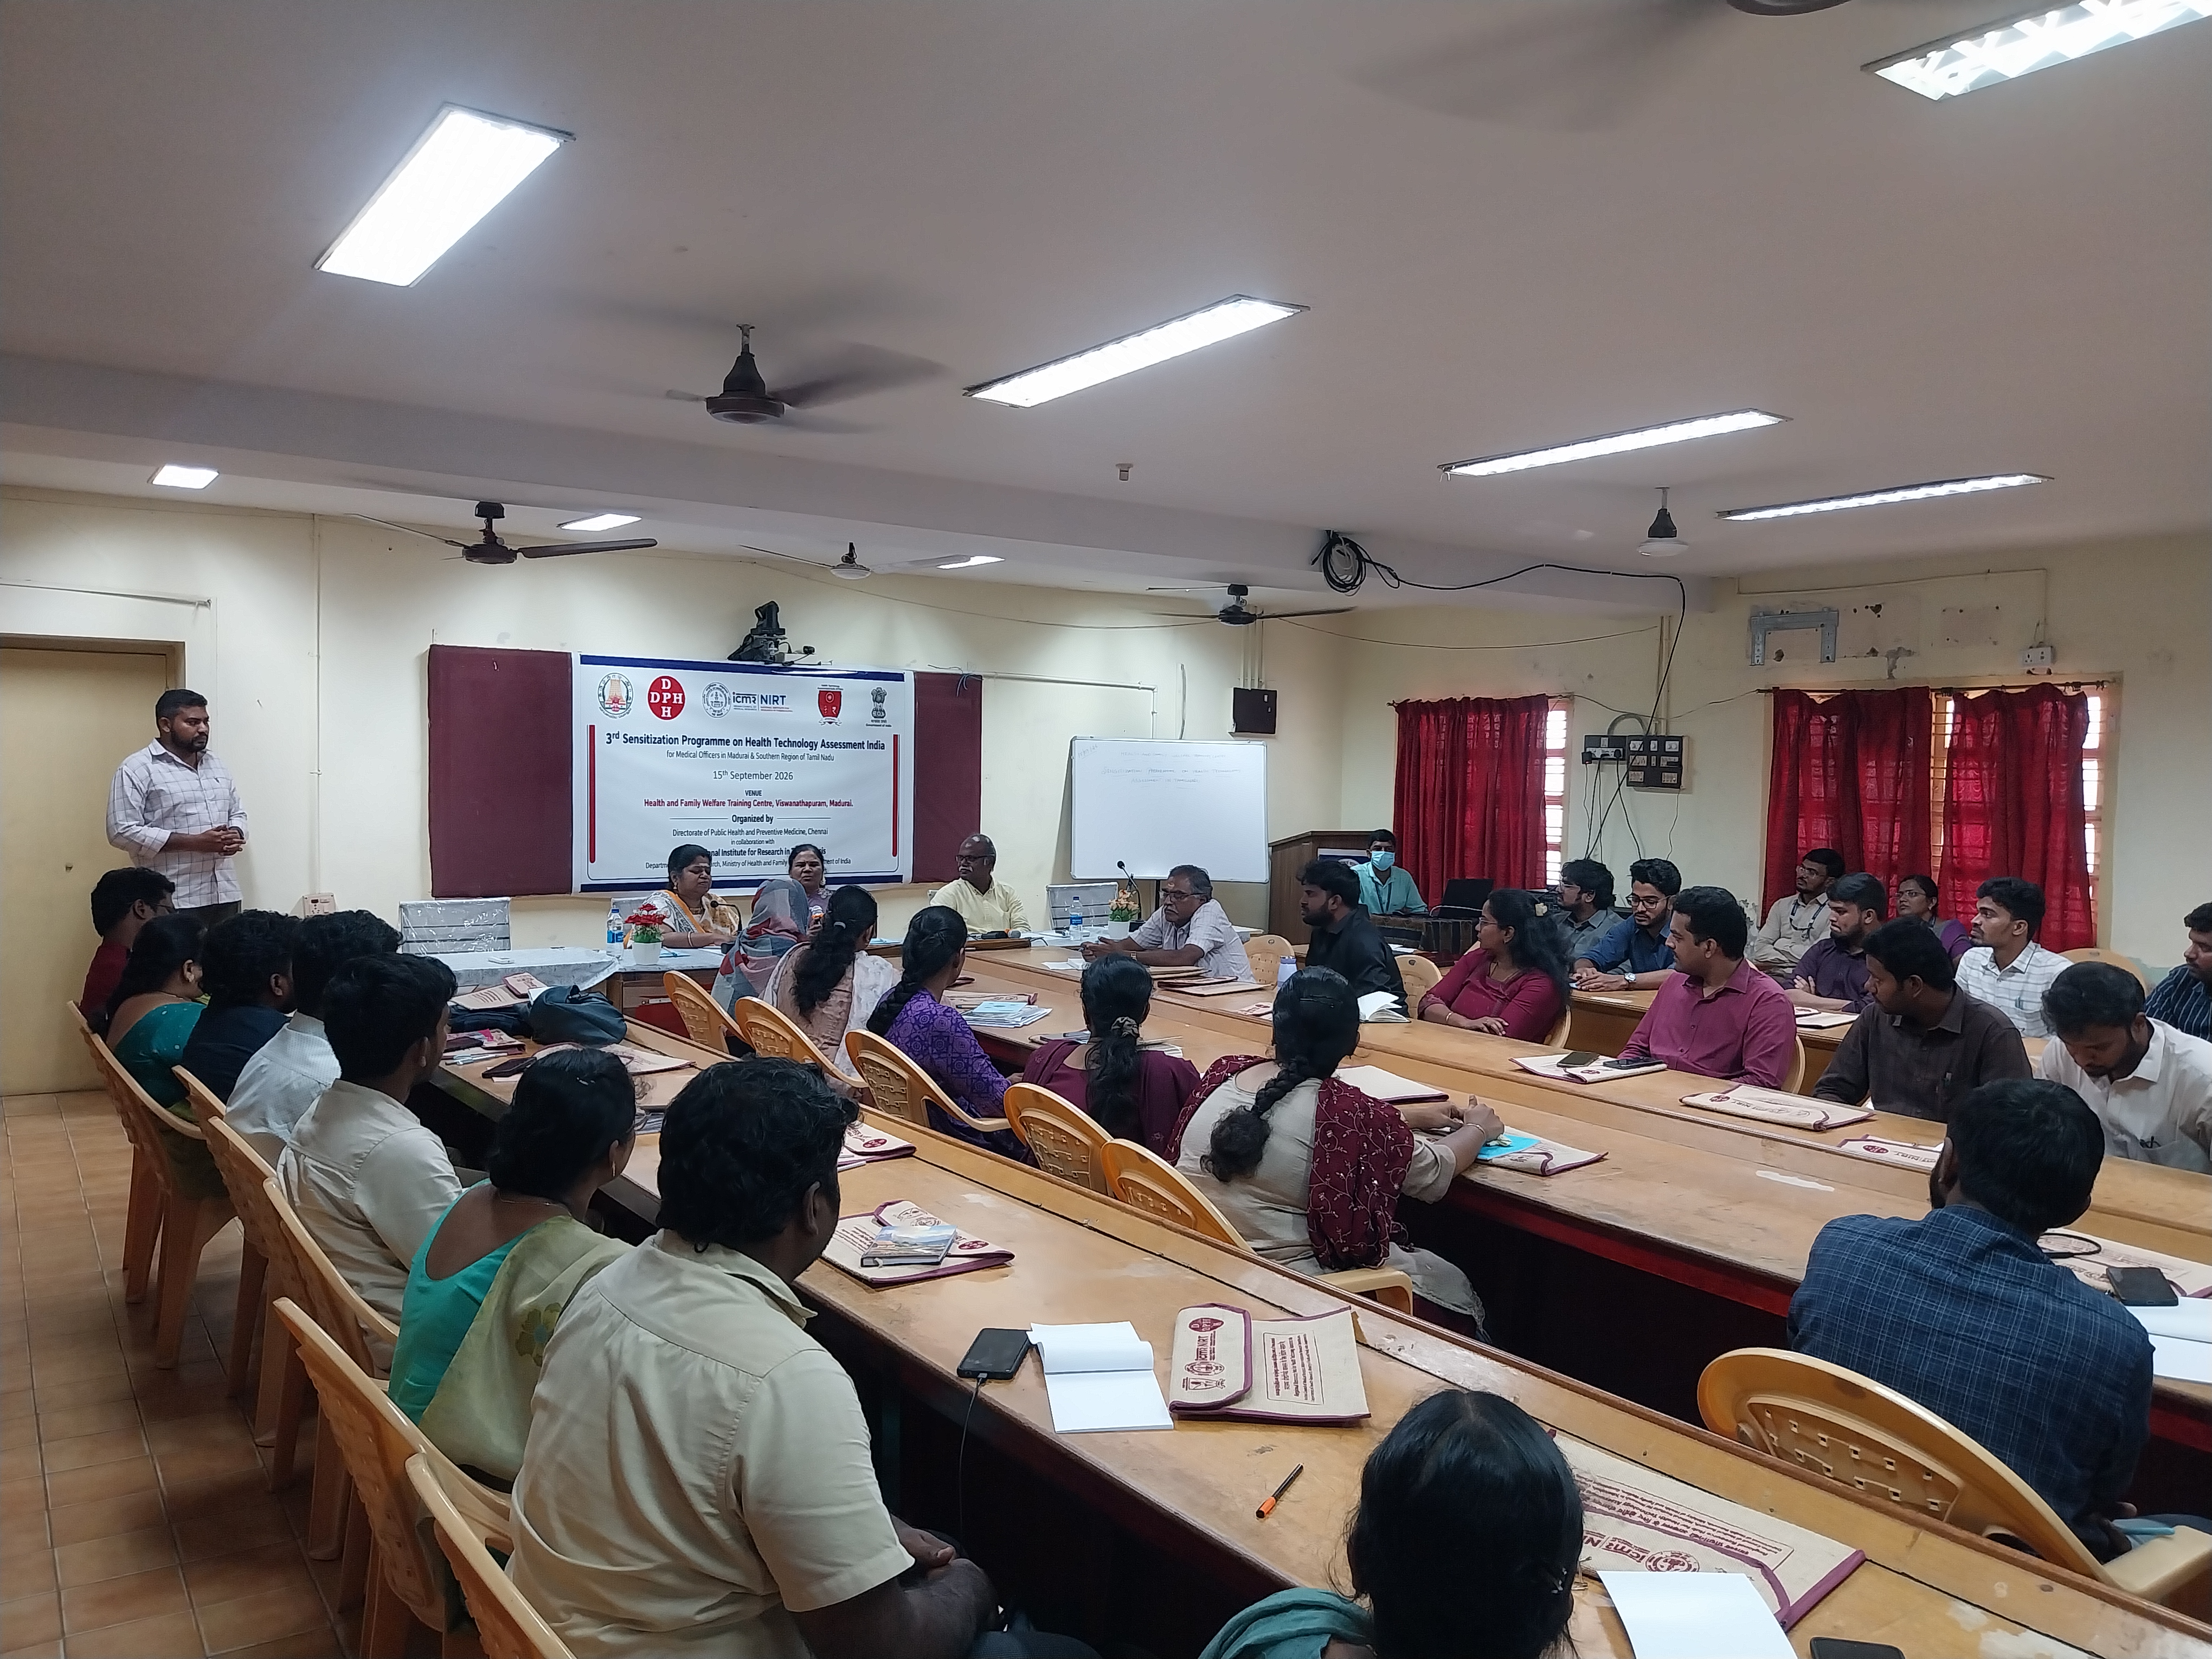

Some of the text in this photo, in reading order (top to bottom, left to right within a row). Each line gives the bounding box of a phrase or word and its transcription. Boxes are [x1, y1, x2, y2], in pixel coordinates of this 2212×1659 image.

[661, 678, 671, 689] D
[650, 692, 683, 704] DPH
[761, 695, 786, 705] NIRT
[661, 706, 671, 717] H
[606, 731, 619, 744] 3rd
[623, 734, 679, 744] Sensitization
[682, 735, 730, 747] Programme
[745, 737, 771, 747] Health
[774, 738, 818, 750] Technology
[821, 740, 865, 749] Assessment
[867, 741, 884, 750] India
[781, 754, 799, 762] Region
[713, 770, 728, 779] 15th
[730, 771, 772, 781] September
[680, 799, 700, 808] Family
[728, 799, 751, 808] Training
[753, 800, 774, 808] Centre,
[776, 800, 827, 808] Viswanathapuram,
[732, 814, 773, 824] Organized by
[1202, 1319, 1211, 1331] DPH
[1197, 1335, 1209, 1347] NIRT
